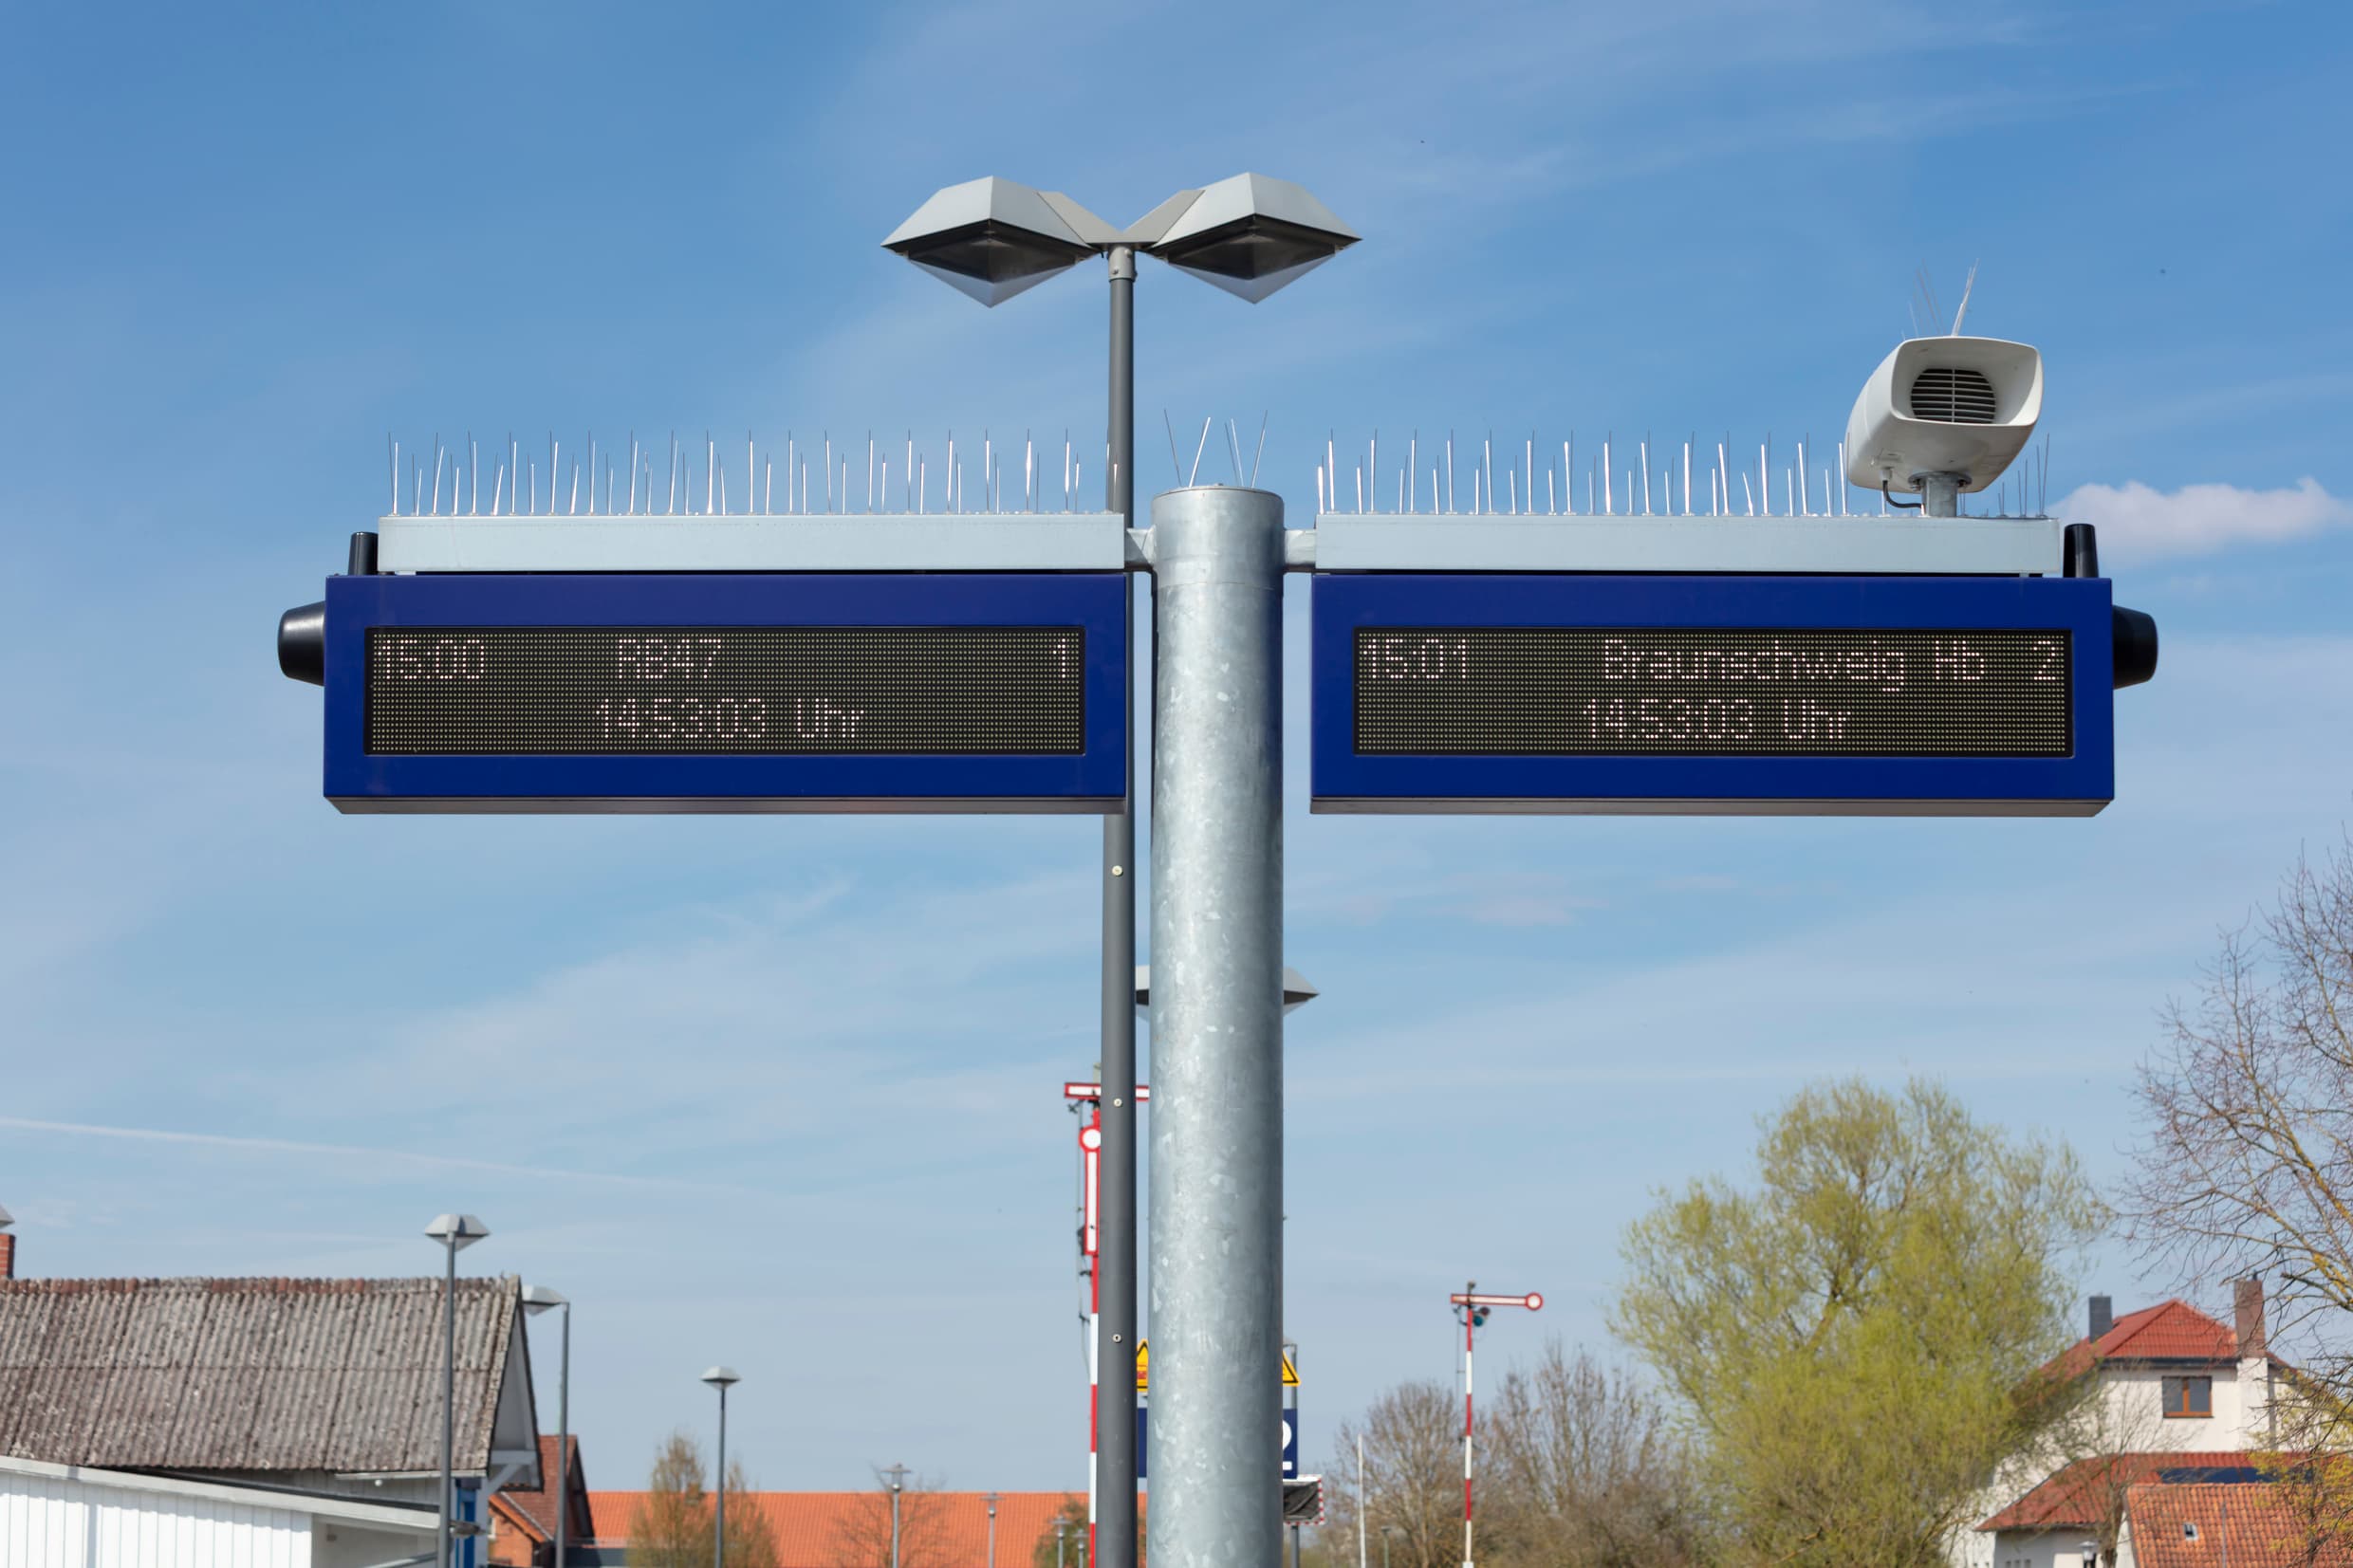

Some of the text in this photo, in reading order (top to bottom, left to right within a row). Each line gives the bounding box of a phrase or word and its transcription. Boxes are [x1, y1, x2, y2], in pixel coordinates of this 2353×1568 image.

[377, 637, 1067, 680] 15:00 RB47 1
[1362, 637, 2057, 692] 15:01 Braunschweig Hb 2
[595, 697, 865, 739] 14:53:03 Uhr
[1582, 697, 1852, 740] 14:53:03 Uhr
